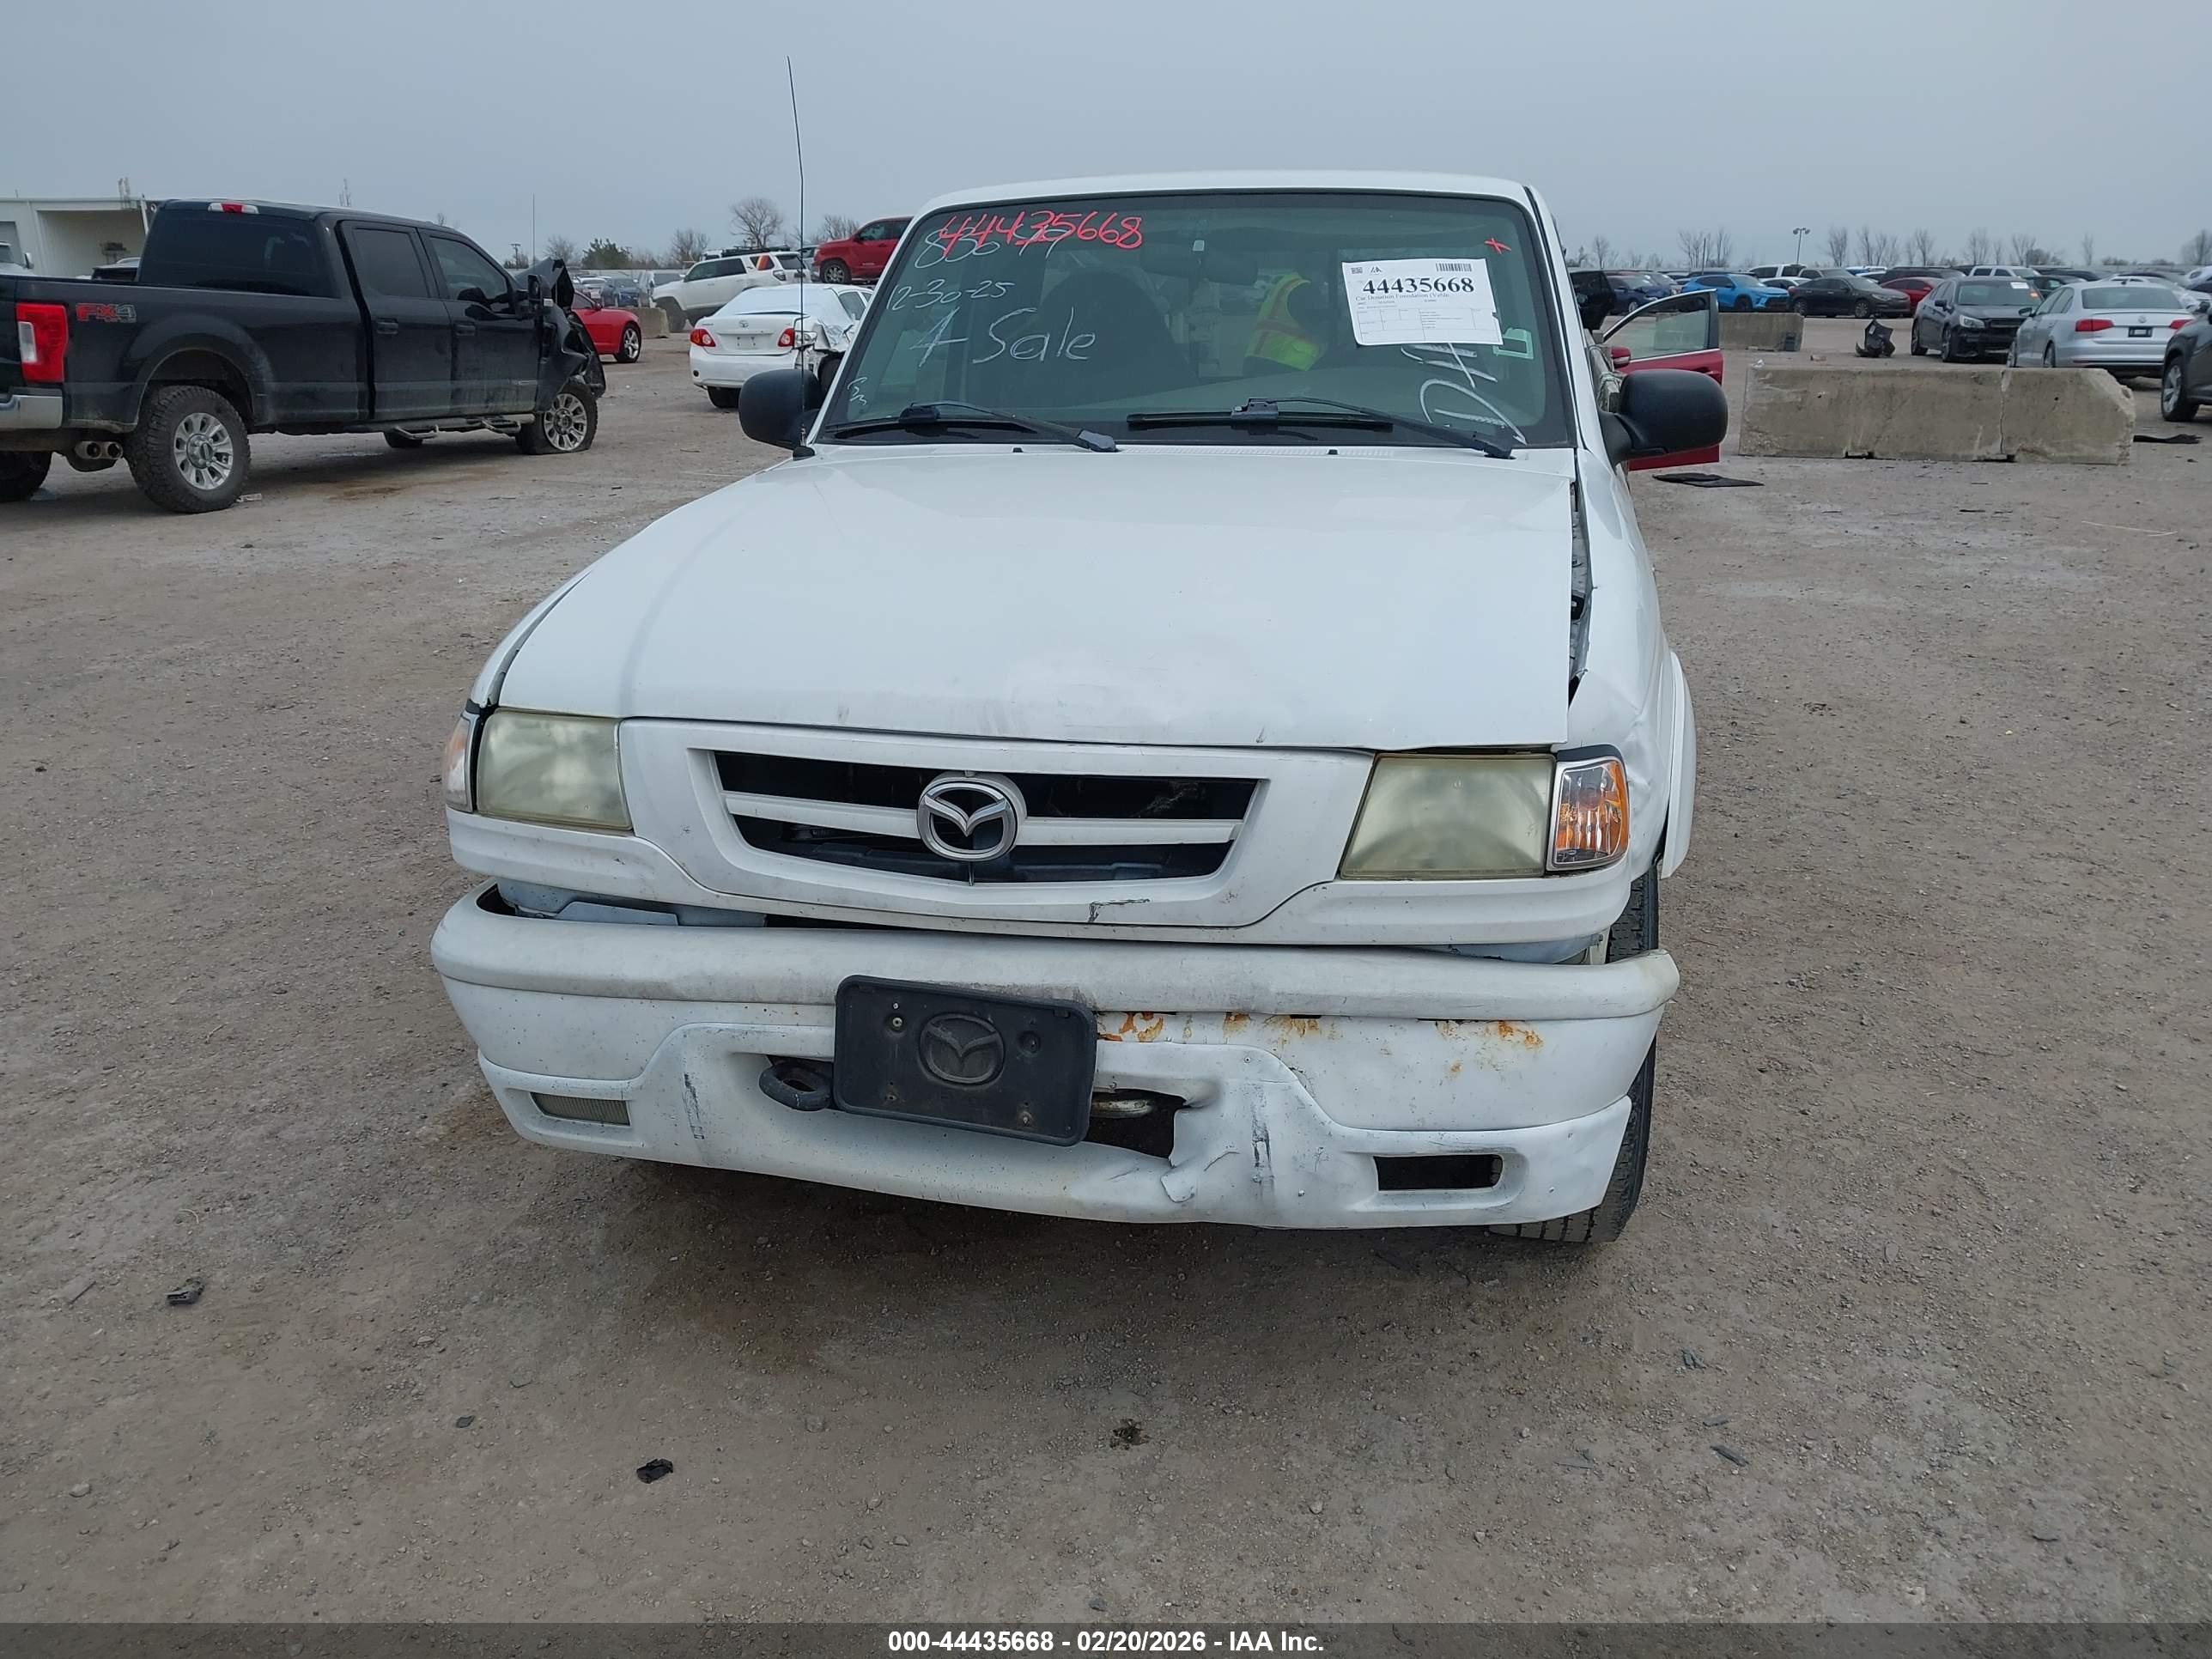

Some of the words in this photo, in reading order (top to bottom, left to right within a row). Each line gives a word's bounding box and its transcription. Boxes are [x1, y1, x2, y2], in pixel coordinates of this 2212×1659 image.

[939, 210, 1143, 258] 44435668
[886, 278, 1017, 311] 12-30-25
[1363, 276, 1475, 295] 44435668
[76, 302, 137, 323] FX4
[972, 307, 1097, 364] Sale
